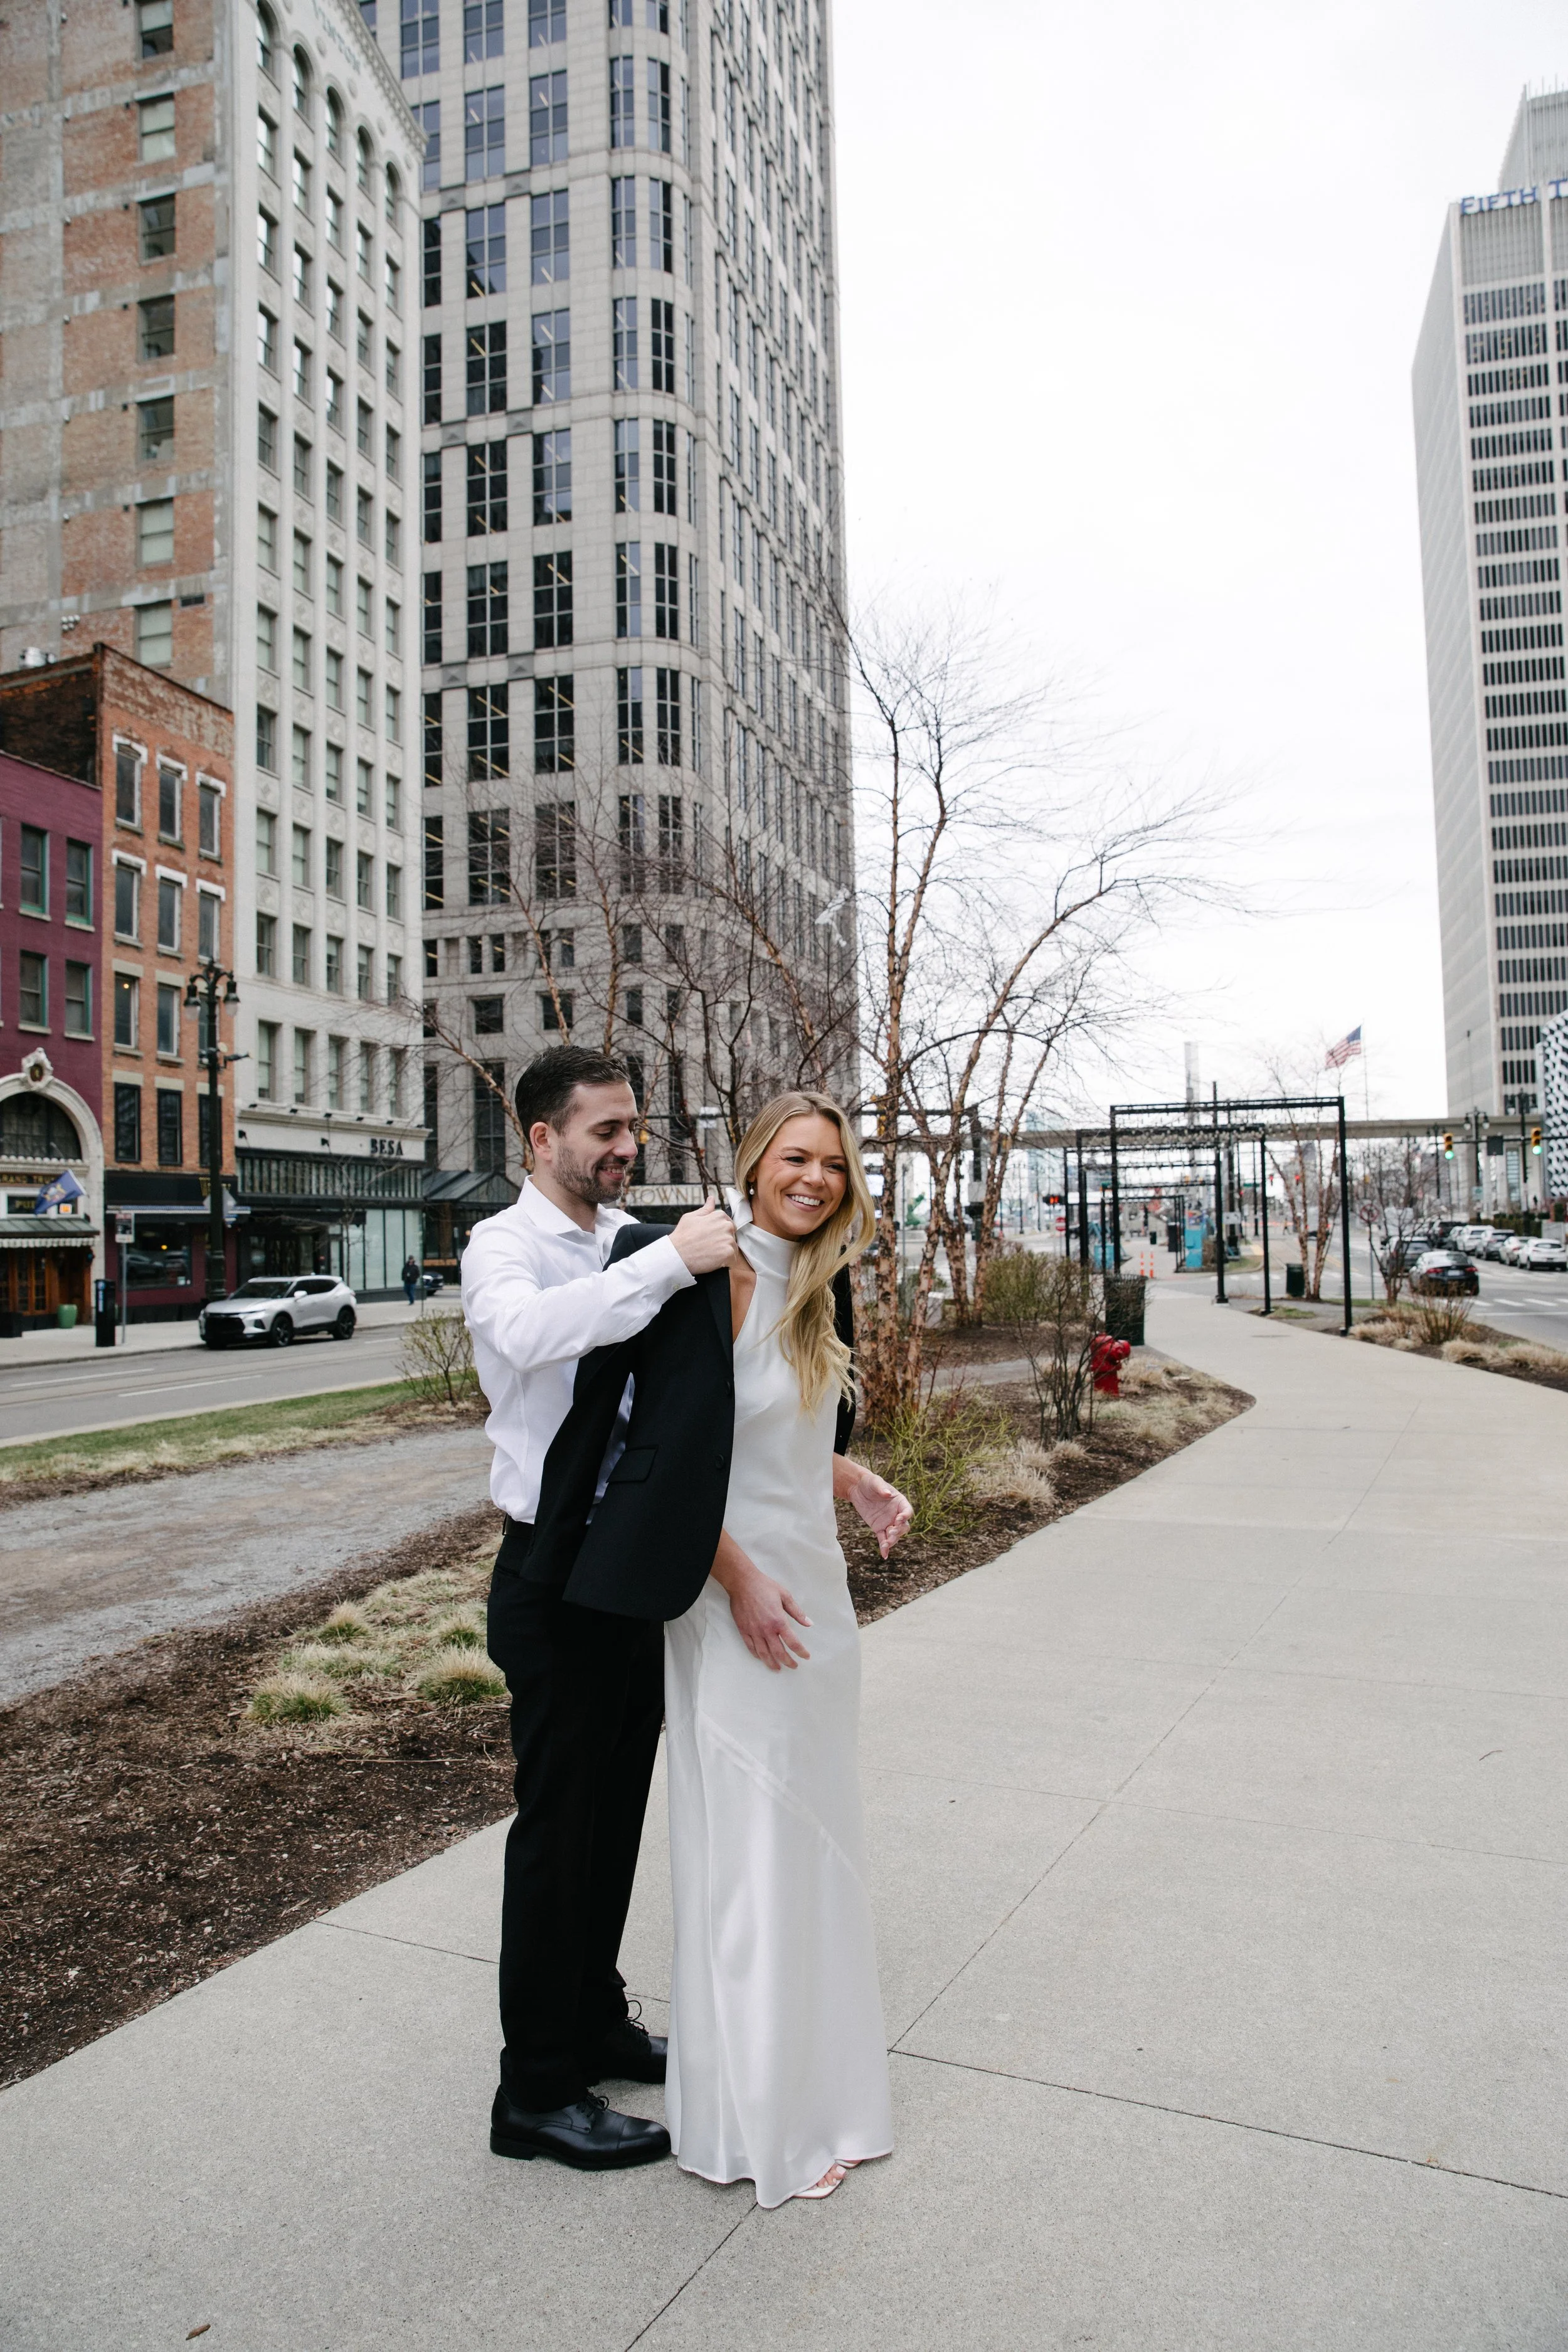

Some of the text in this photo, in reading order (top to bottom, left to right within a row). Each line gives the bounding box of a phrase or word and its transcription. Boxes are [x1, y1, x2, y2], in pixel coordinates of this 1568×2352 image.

[1461, 186, 1537, 215] FIFTH
[371, 1138, 403, 1155] BESA
[627, 1187, 718, 1204] TOWNH
